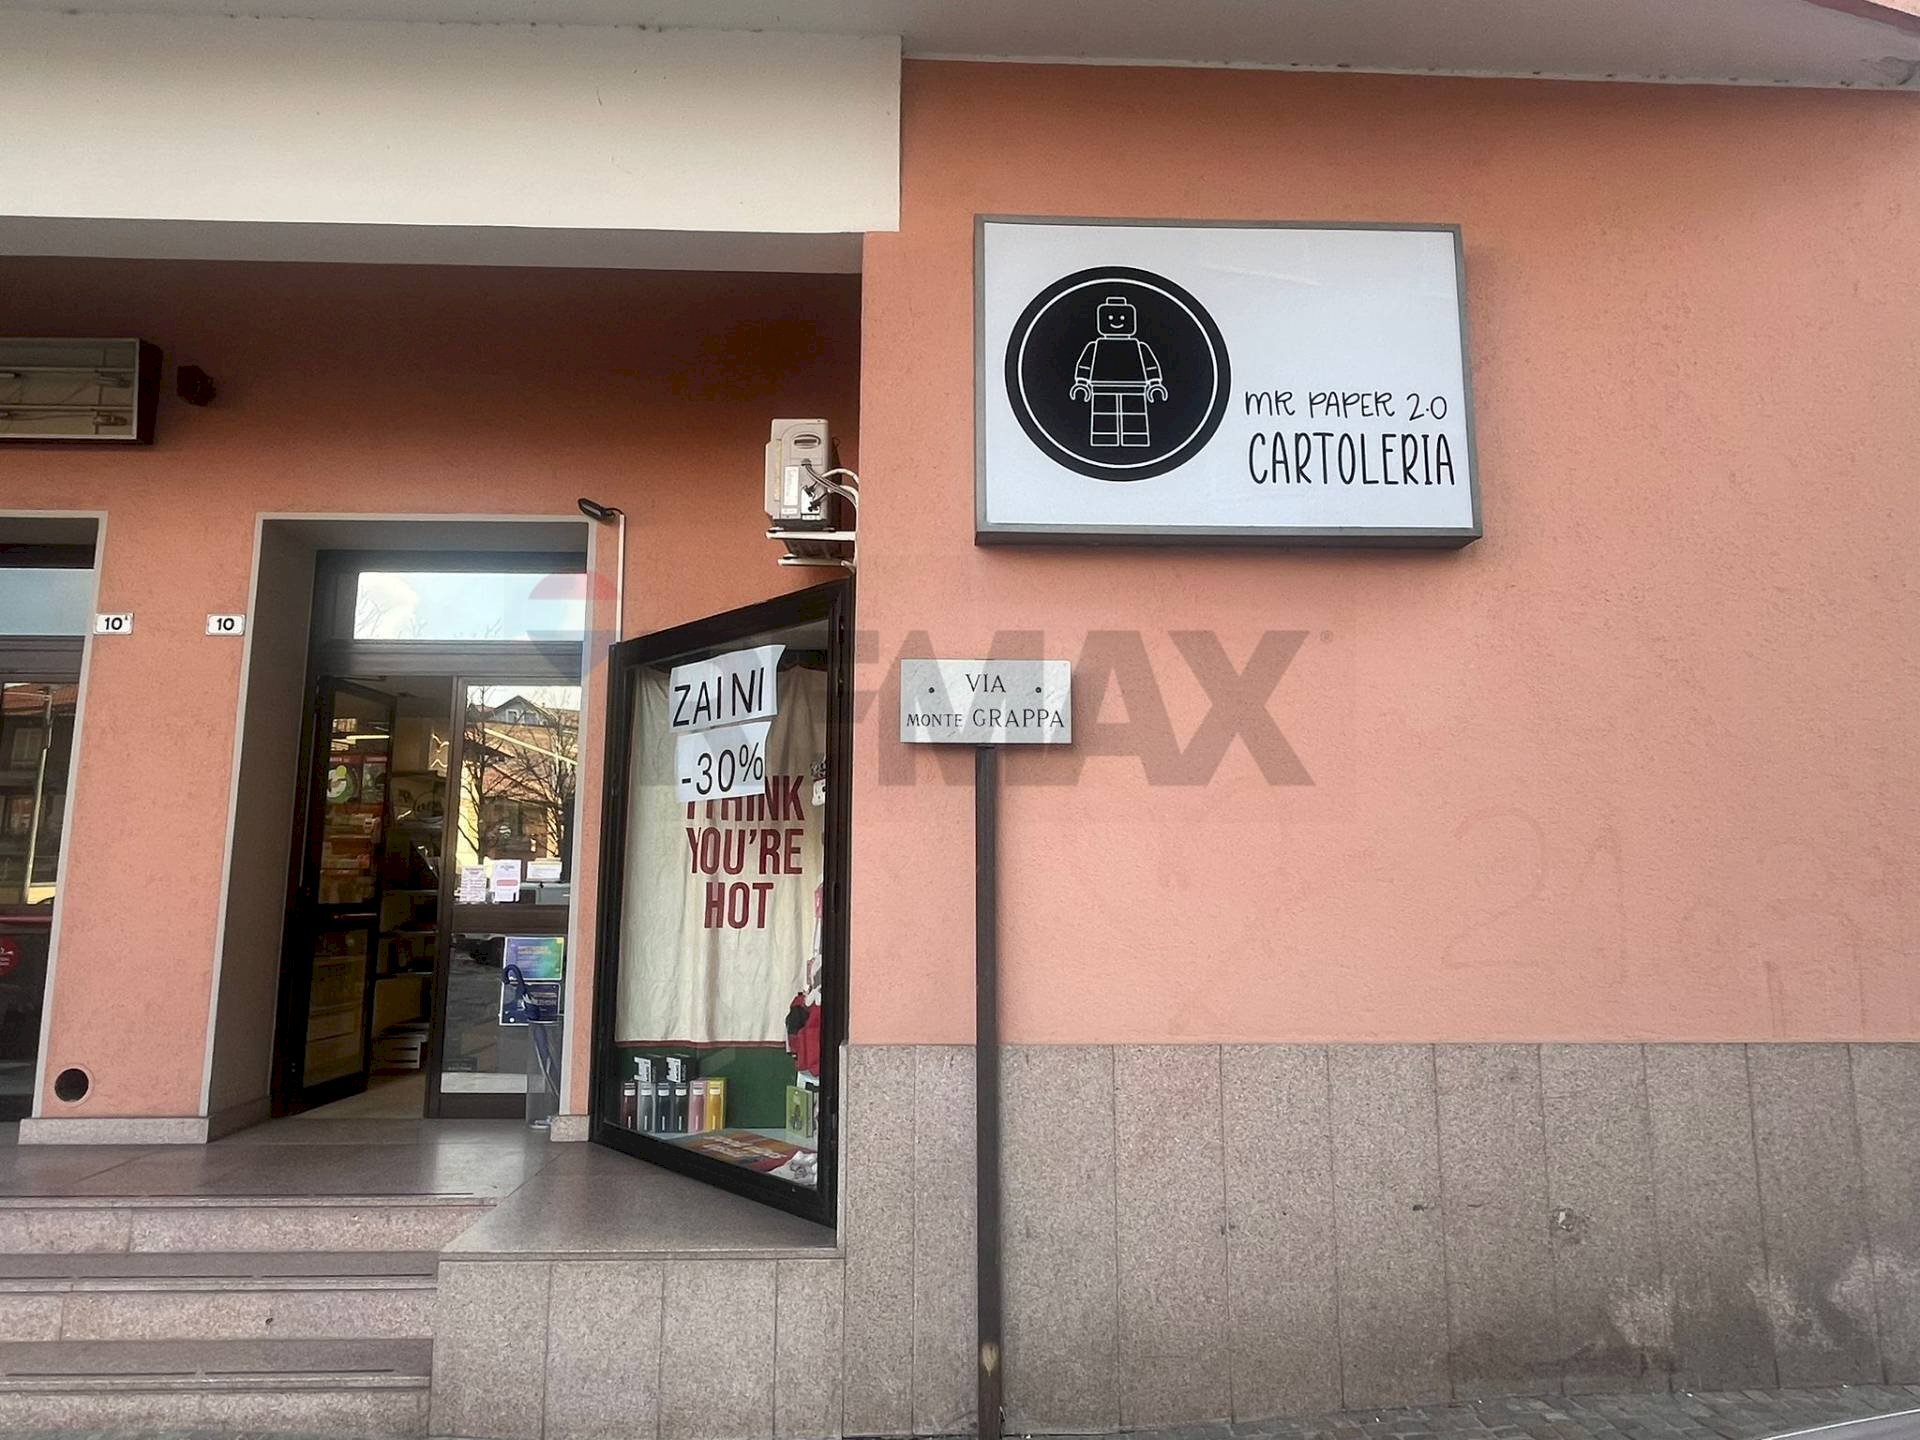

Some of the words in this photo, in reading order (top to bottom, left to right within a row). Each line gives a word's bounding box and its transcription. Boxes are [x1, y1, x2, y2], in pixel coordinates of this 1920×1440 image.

[1245, 389, 1296, 417] MR
[1308, 391, 1395, 419] PAPER
[1406, 392, 1448, 421] 2.0
[1249, 431, 1456, 486] CARTOLERIA
[216, 617, 235, 631] 10
[965, 673, 1006, 693] VIA
[906, 713, 963, 728] MONTE
[972, 708, 1065, 728] GRAPPA
[681, 742, 764, 795] -30%
[686, 826, 805, 875] YOU'RE
[704, 881, 774, 929] HOT
